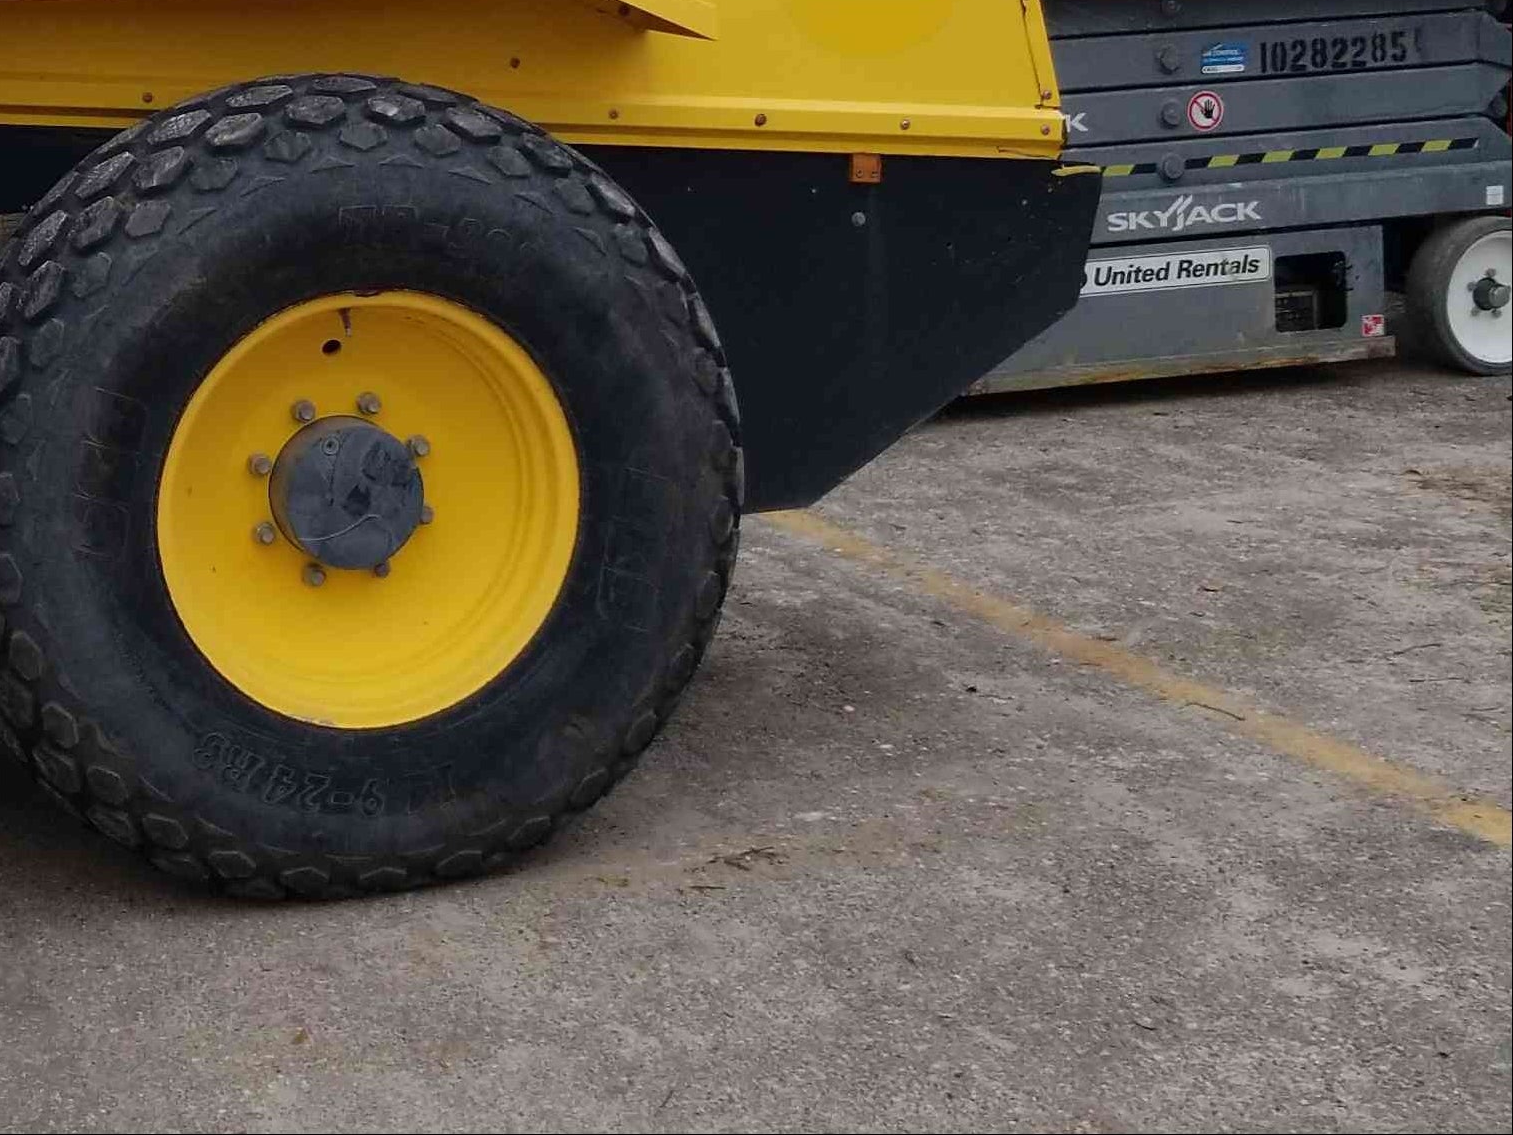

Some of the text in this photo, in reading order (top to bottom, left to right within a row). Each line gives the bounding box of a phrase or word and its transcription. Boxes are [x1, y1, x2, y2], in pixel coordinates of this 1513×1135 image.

[1259, 31, 1408, 74] 10282285
[1106, 194, 1262, 232] SKYJACK
[1093, 254, 1261, 287] United Rentals
